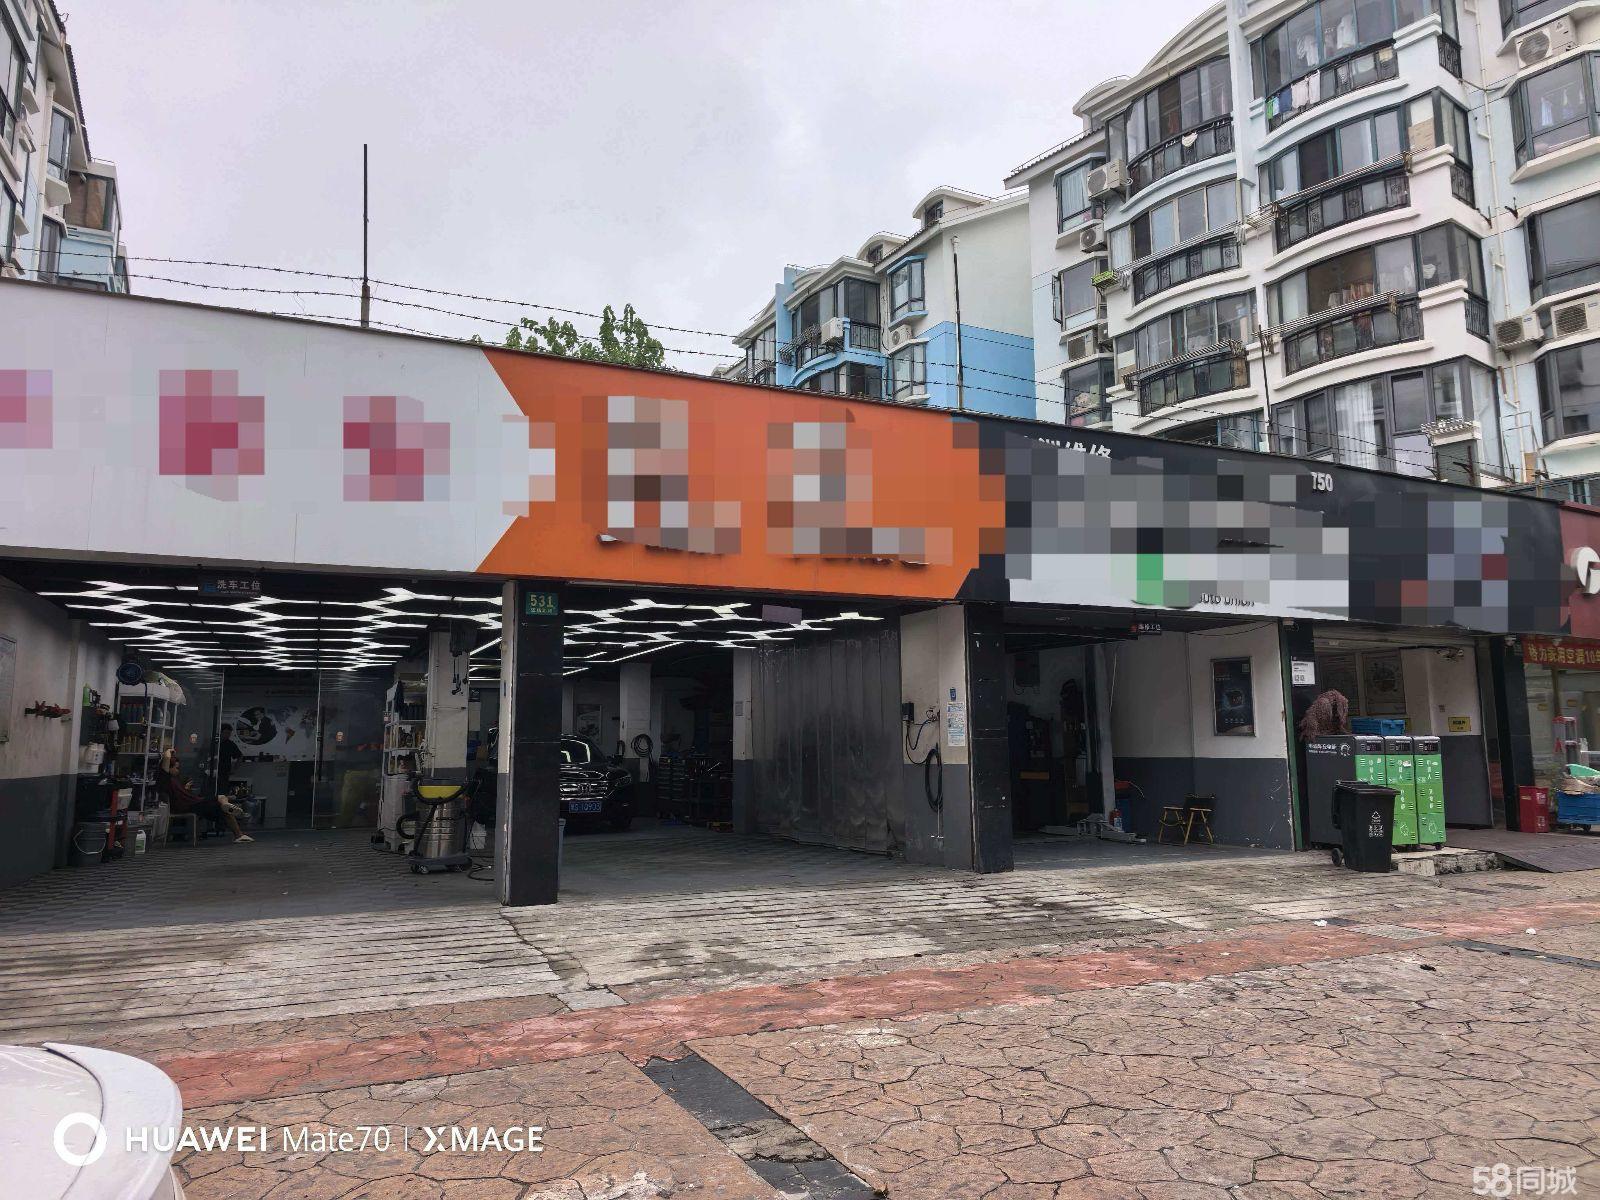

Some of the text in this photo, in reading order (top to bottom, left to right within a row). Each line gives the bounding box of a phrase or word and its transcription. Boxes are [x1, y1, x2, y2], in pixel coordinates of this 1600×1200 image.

[217, 579, 261, 591] 洗车工位
[530, 594, 554, 608] 531
